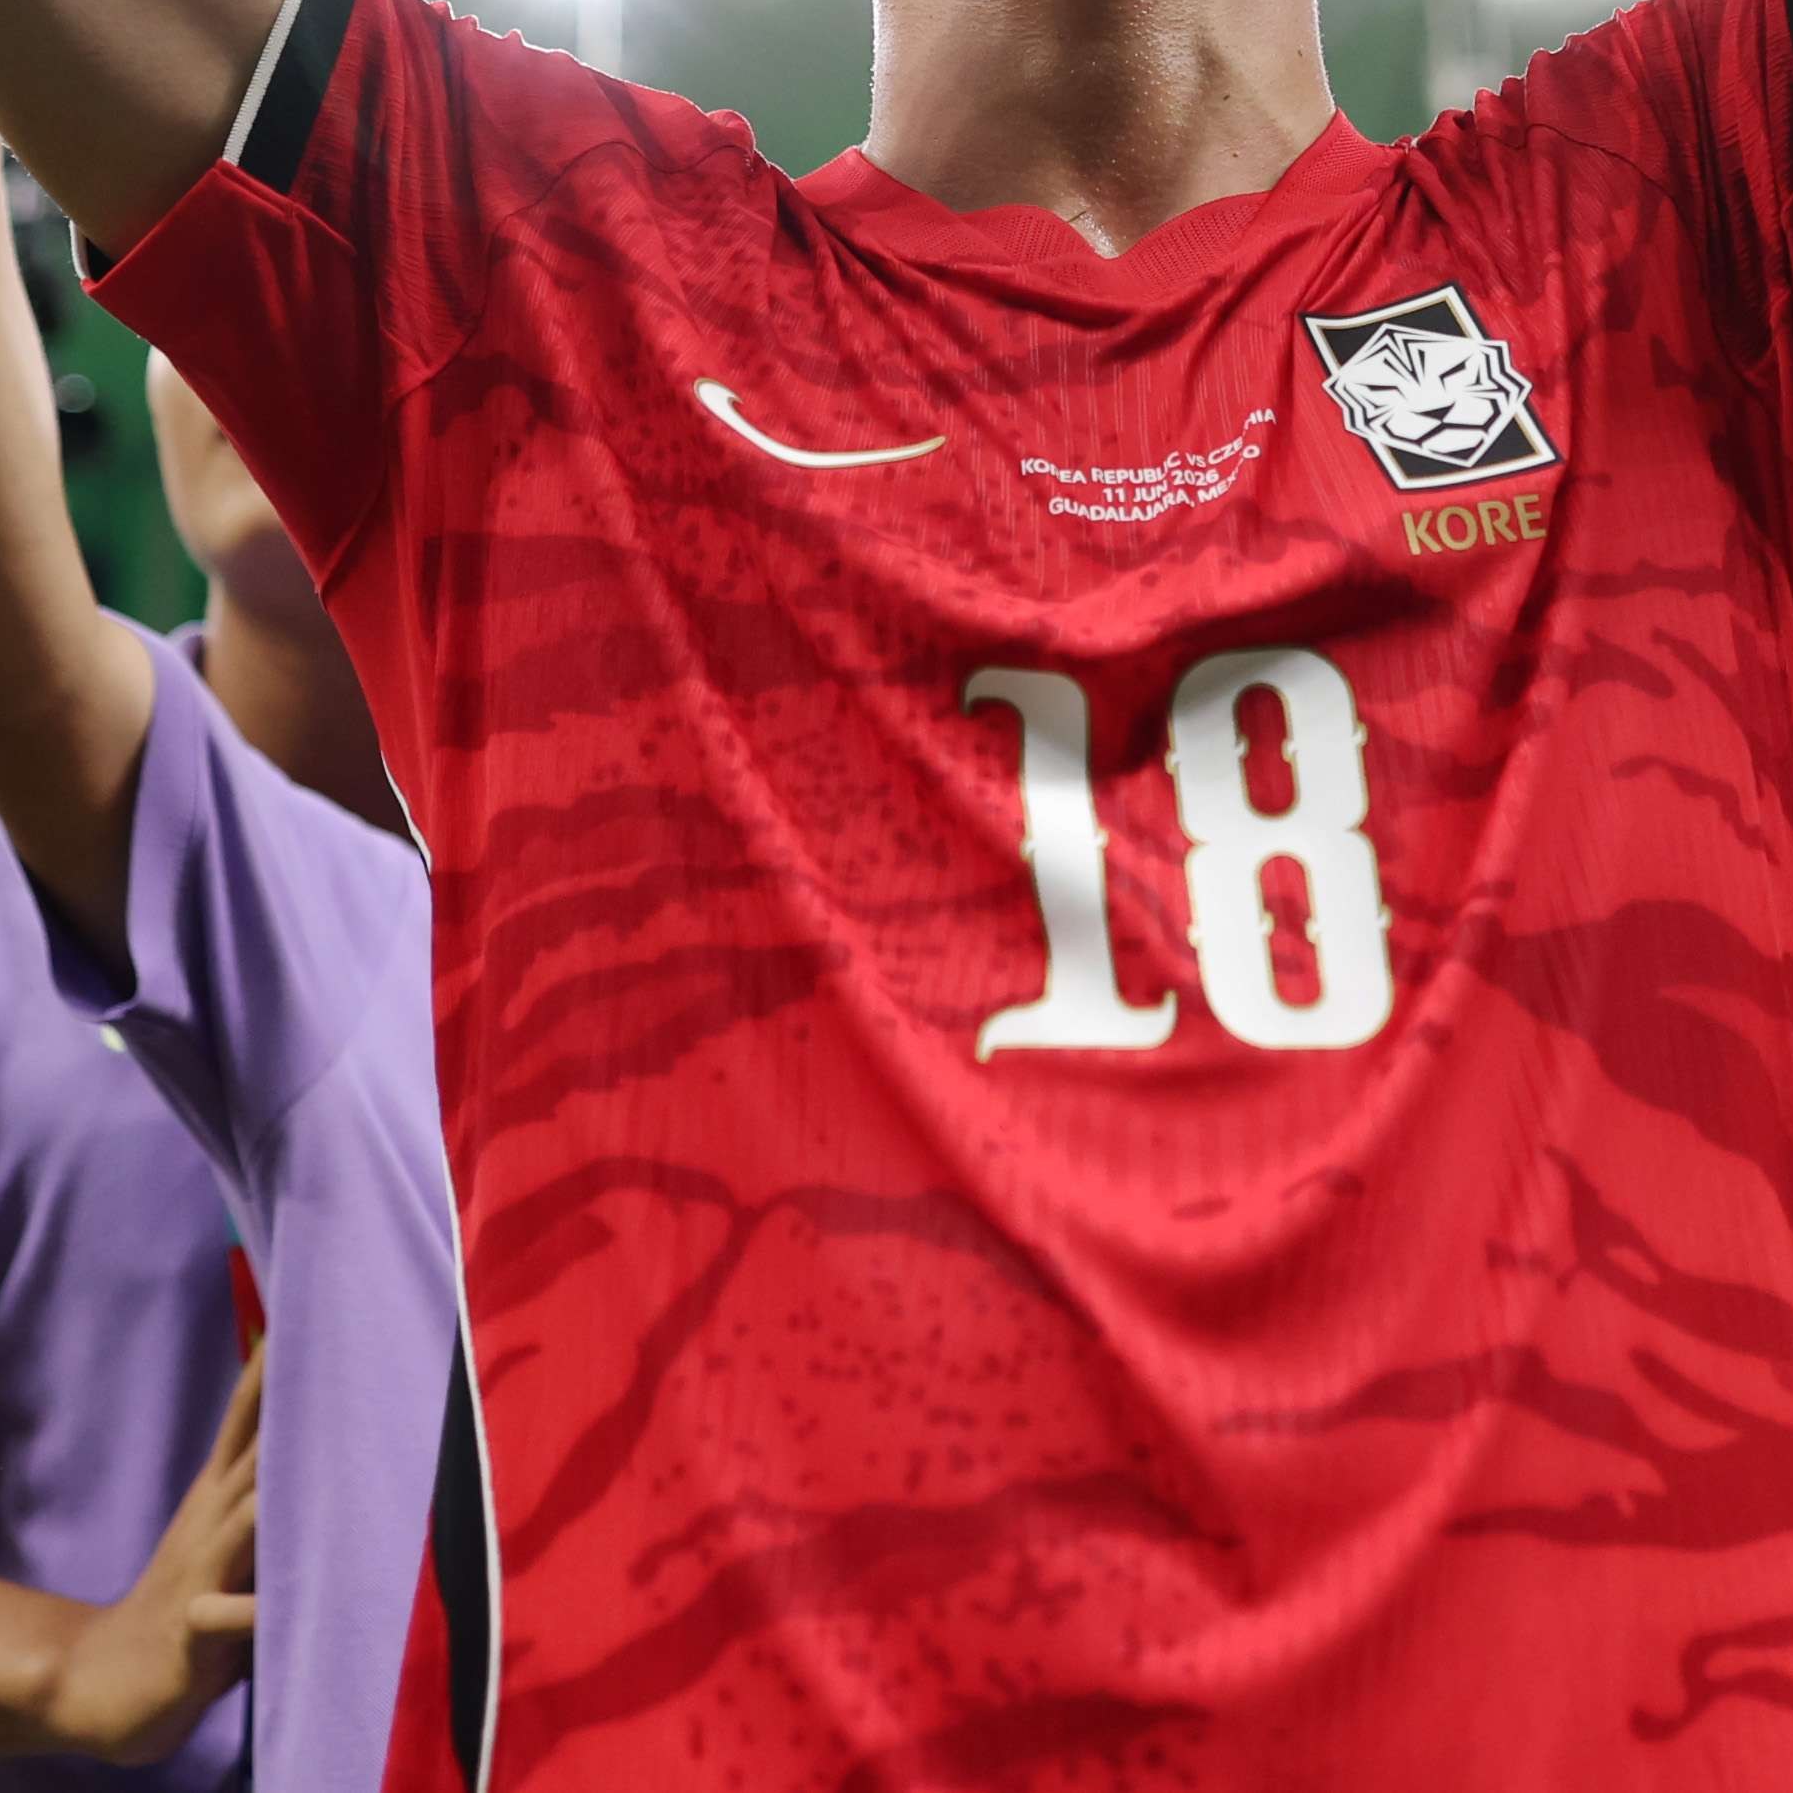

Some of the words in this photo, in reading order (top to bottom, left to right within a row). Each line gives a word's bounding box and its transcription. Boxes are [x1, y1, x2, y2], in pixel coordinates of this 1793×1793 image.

[1186, 453, 1206, 468] VS
[1103, 487, 1125, 502] 11
[1132, 480, 1168, 502] JUN
[1172, 469, 1219, 486] 2026
[1402, 493, 1547, 555] KORE
[963, 647, 1393, 1063] 18
